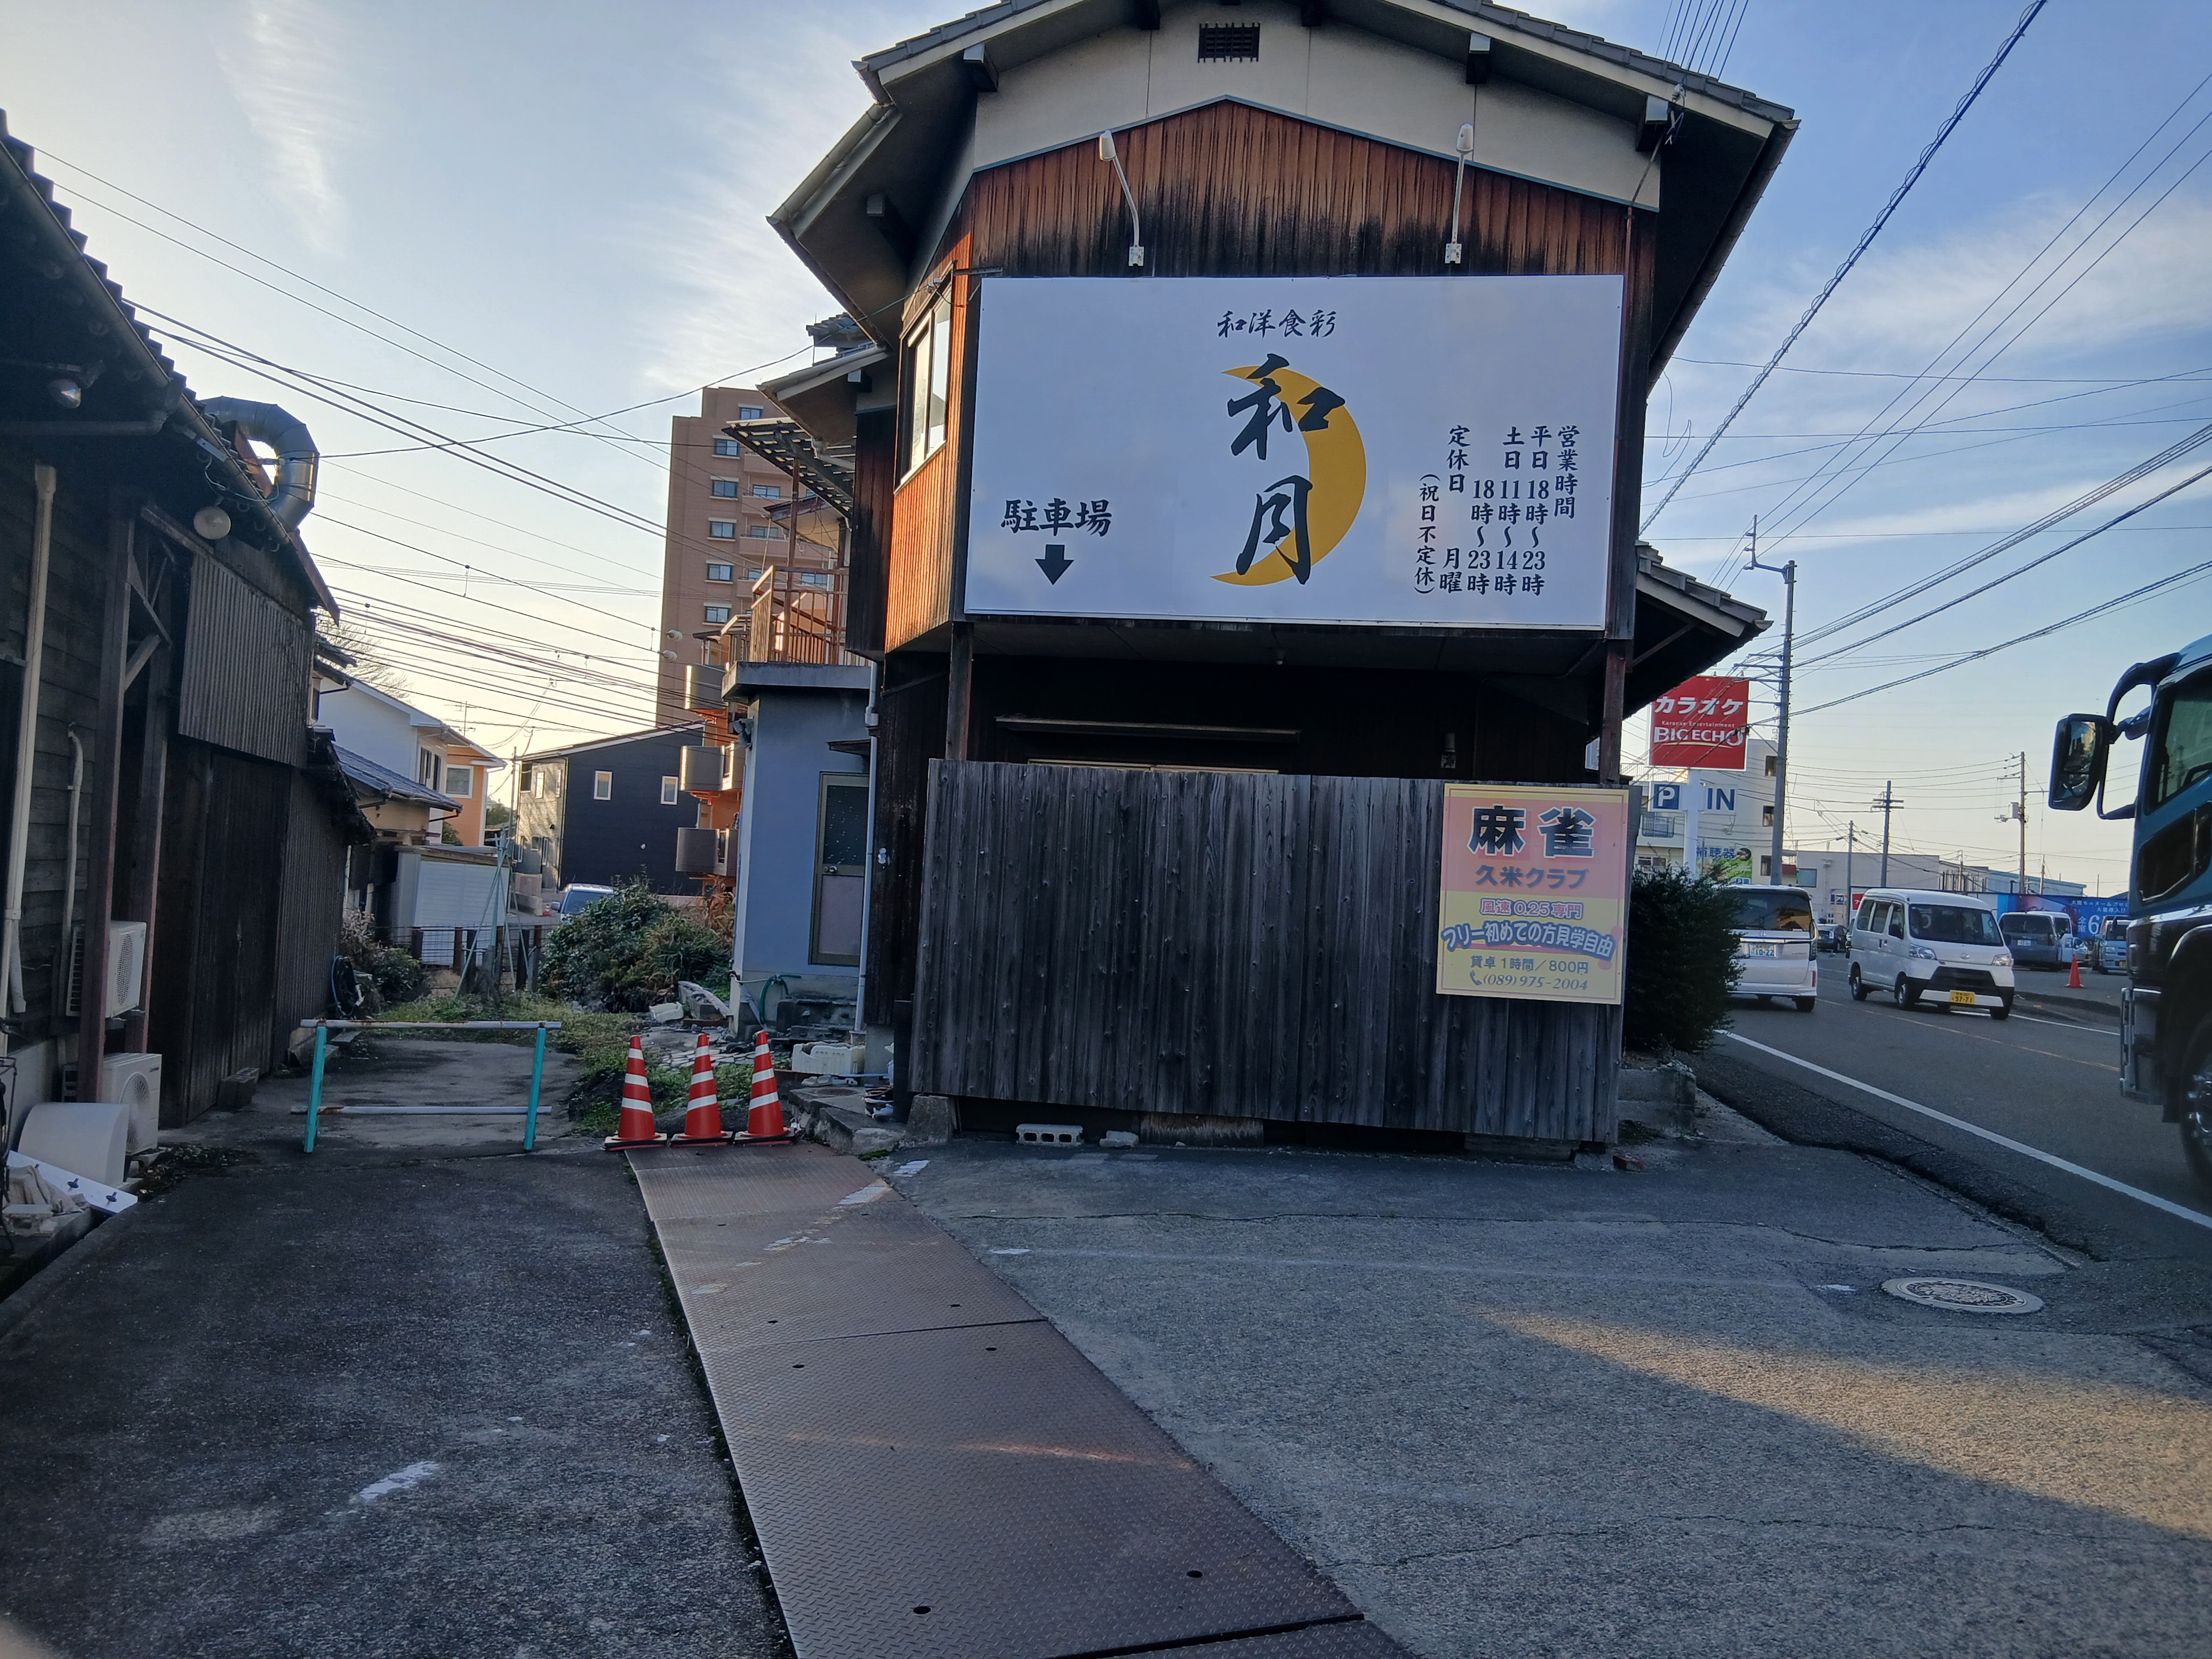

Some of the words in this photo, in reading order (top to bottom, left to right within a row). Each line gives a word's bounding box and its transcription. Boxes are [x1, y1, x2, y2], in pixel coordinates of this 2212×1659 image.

[1217, 309, 1336, 338] 和洋食彩
[1226, 352, 1346, 586] 和月
[1446, 425, 1471, 494] 定休日
[1553, 425, 1581, 519] 営業時間
[1000, 498, 1112, 538] 駐車場
[1413, 473, 1441, 594] (祝日不定休)
[1439, 547, 1463, 594] 月曜
[1654, 696, 1744, 716] カラオケ
[1707, 788, 1734, 811] IN
[1467, 803, 1597, 858] 麻雀
[1442, 922, 1614, 958] フリー初めての方見学自由
